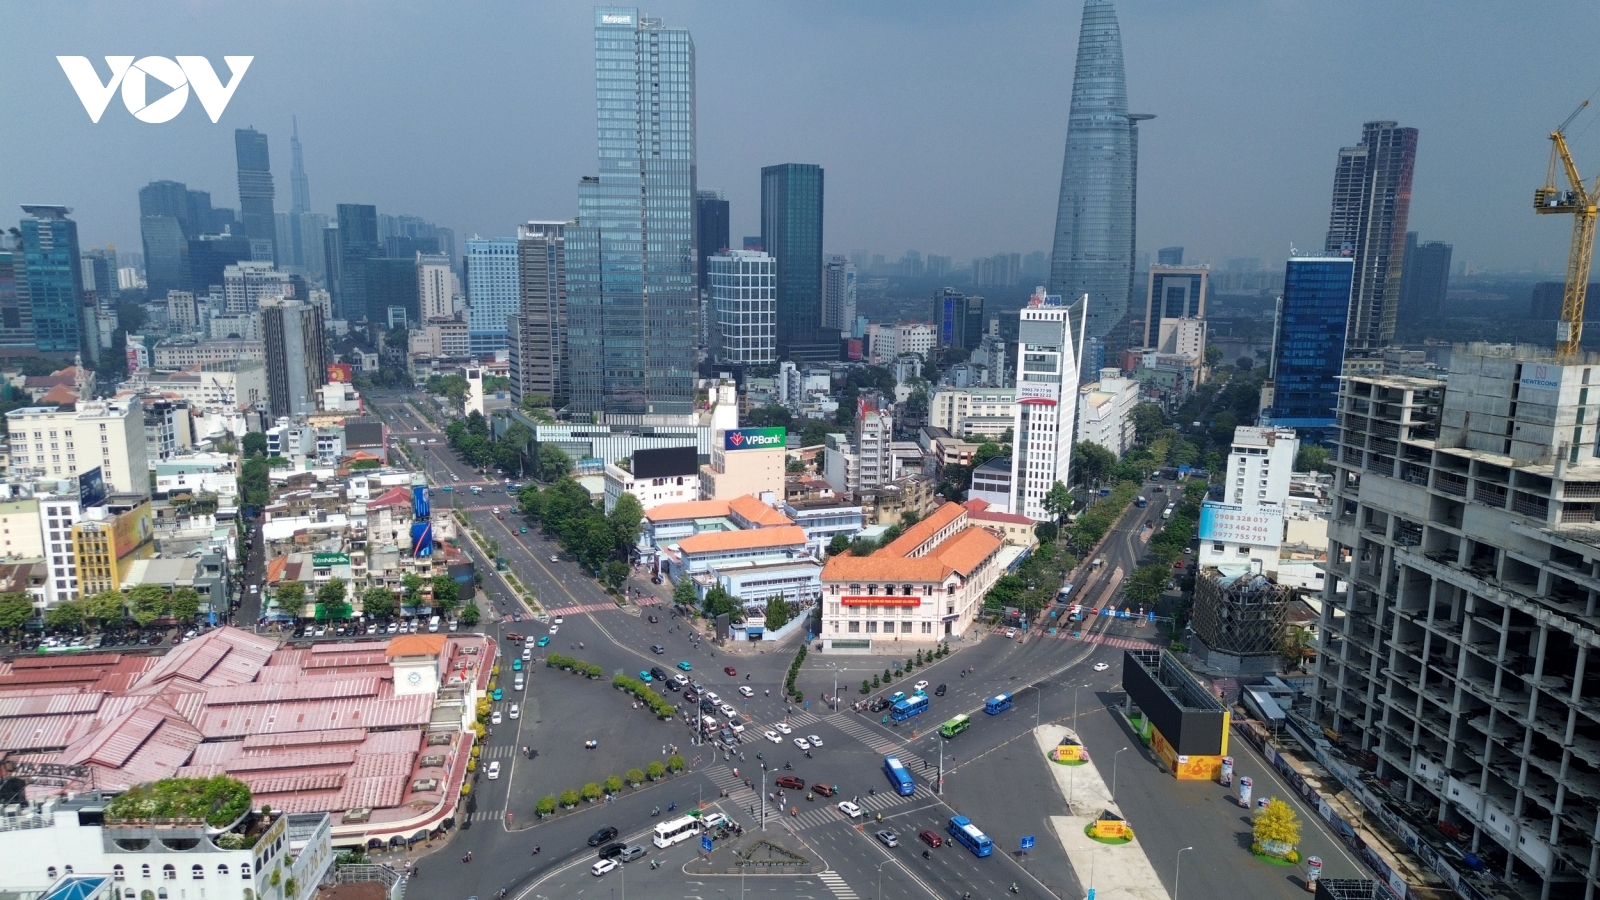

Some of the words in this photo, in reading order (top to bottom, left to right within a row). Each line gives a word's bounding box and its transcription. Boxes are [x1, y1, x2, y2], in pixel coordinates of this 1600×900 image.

[603, 15, 630, 24] Keppel
[255, 244, 268, 252] FOR
[1521, 378, 1558, 387] NEWTECONS
[745, 434, 781, 445] VPBank
